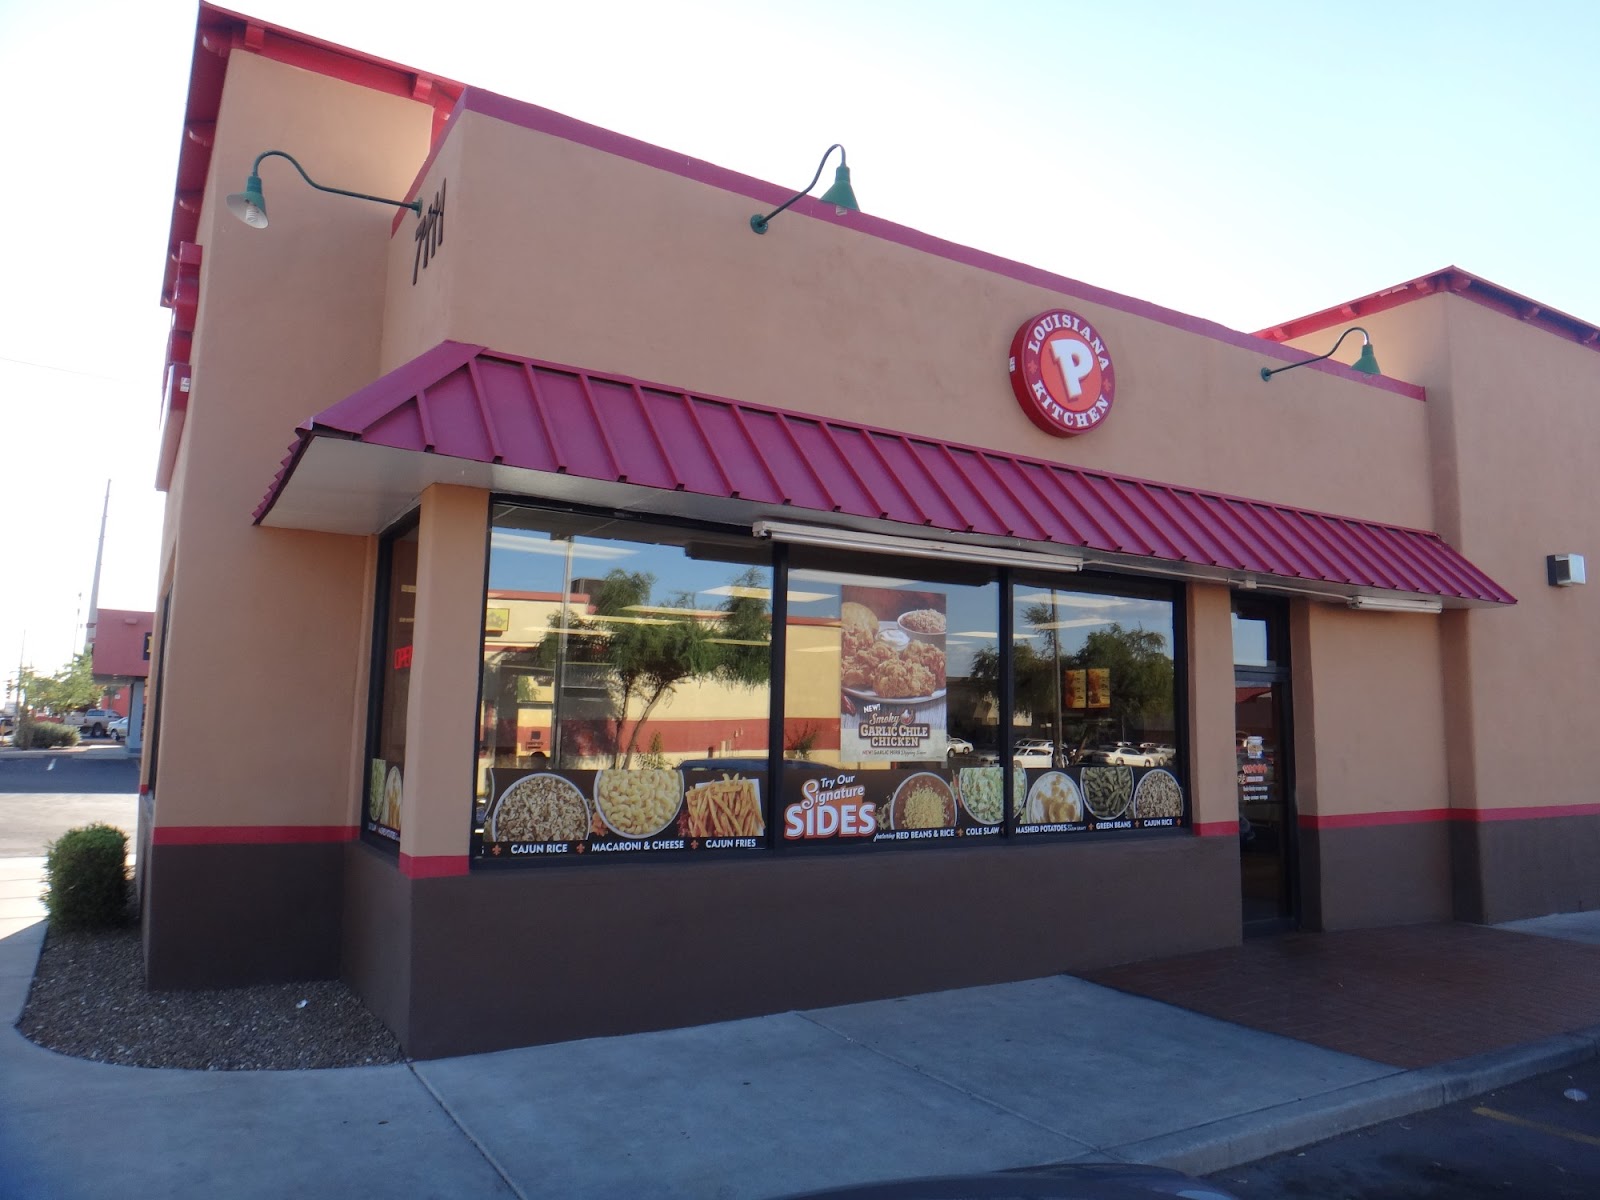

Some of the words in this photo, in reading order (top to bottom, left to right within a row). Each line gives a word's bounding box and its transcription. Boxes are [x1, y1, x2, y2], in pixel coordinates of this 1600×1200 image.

[1028, 314, 1110, 372] LOUISIANA
[1050, 338, 1094, 399] P
[1032, 379, 1109, 428] KITCHEN
[863, 703, 880, 714] NEW!
[869, 712, 900, 726] Smoky
[860, 724, 898, 737] GARLIC
[898, 724, 928, 737] CHILE
[872, 737, 919, 746] CHICKEN
[820, 777, 836, 789] Try
[837, 774, 855, 785] Our
[801, 778, 865, 810] Signature
[785, 804, 876, 837] SIDES
[1096, 822, 1114, 830] GREEN
[1160, 818, 1173, 826] RICE
[896, 831, 910, 840] RED
[910, 830, 933, 839] BEANS
[933, 829, 939, 838] &
[940, 828, 955, 837] RICE
[966, 827, 983, 836] COLE
[983, 826, 1000, 835] SLAW
[1015, 825, 1039, 834] MASHED
[1039, 824, 1067, 833] POTATOES
[510, 844, 544, 854] CAJUN
[546, 843, 568, 853] RICE
[592, 842, 641, 852] MACARONI
[643, 841, 650, 851] &
[652, 840, 684, 850] CHEESE
[705, 839, 734, 849] CAJUN
[735, 838, 756, 848] FRIES
